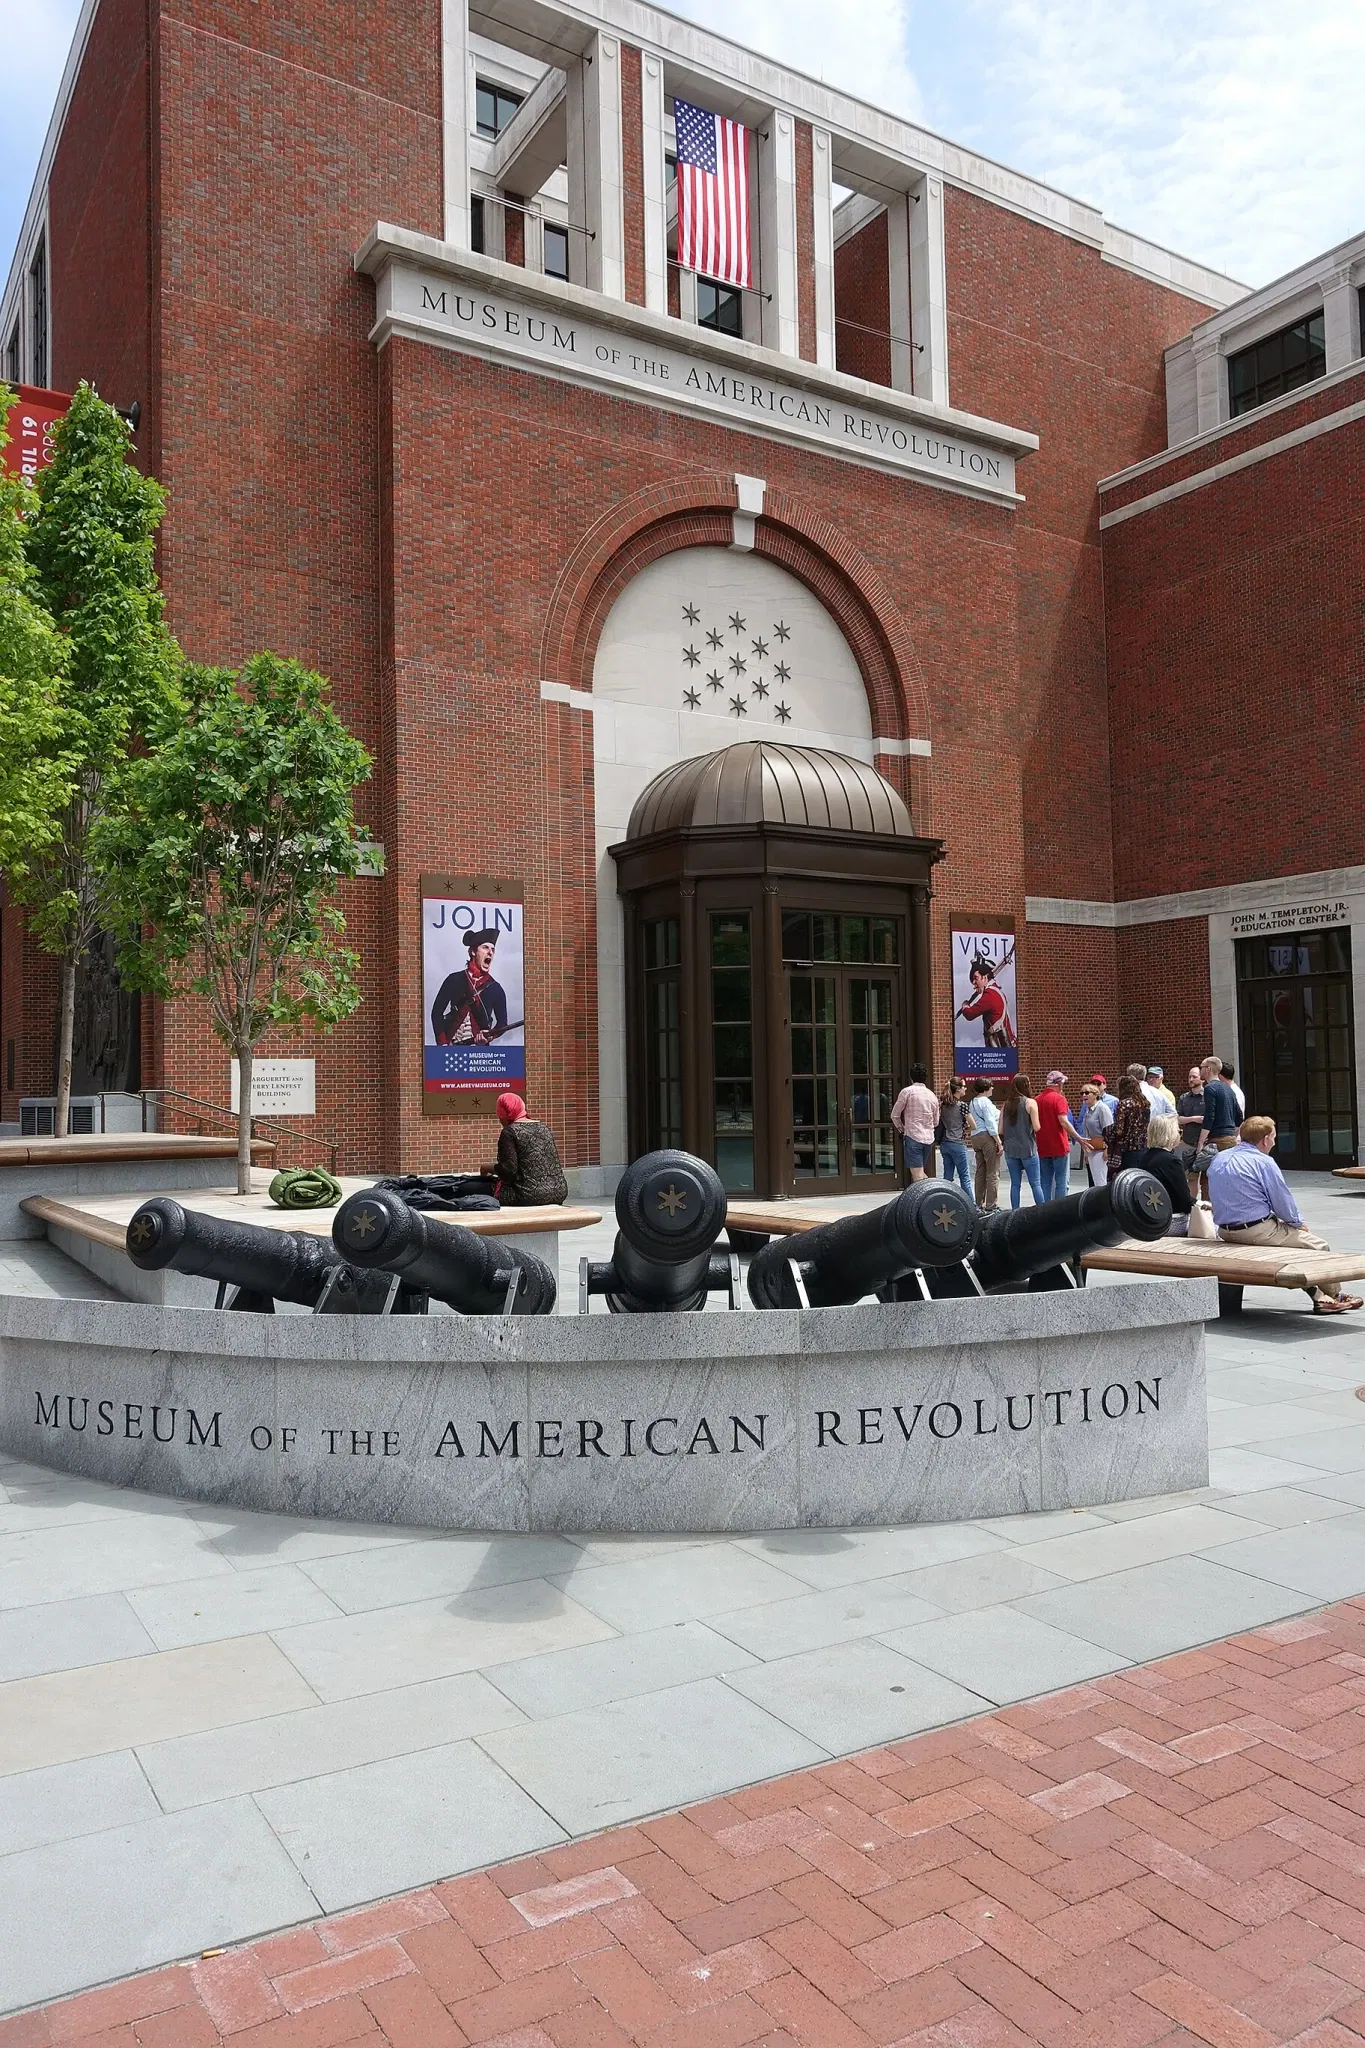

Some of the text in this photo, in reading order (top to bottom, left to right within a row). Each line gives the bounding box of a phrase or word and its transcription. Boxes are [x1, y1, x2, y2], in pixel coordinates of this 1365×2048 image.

[420, 285, 1000, 479] MUSEUM OF THE AMERICAN REVOLUTION
[21, 416, 38, 488] PRIL 19
[432, 904, 512, 932] JOIN
[1231, 902, 1349, 926] JOHN M. TEMPLETON, JR.
[1241, 913, 1339, 932] EDUCATION CENTER
[959, 936, 1009, 958] VISIT
[34, 1377, 1163, 1458] MUSEUM OF THE AMERICAN REVOLUTION
